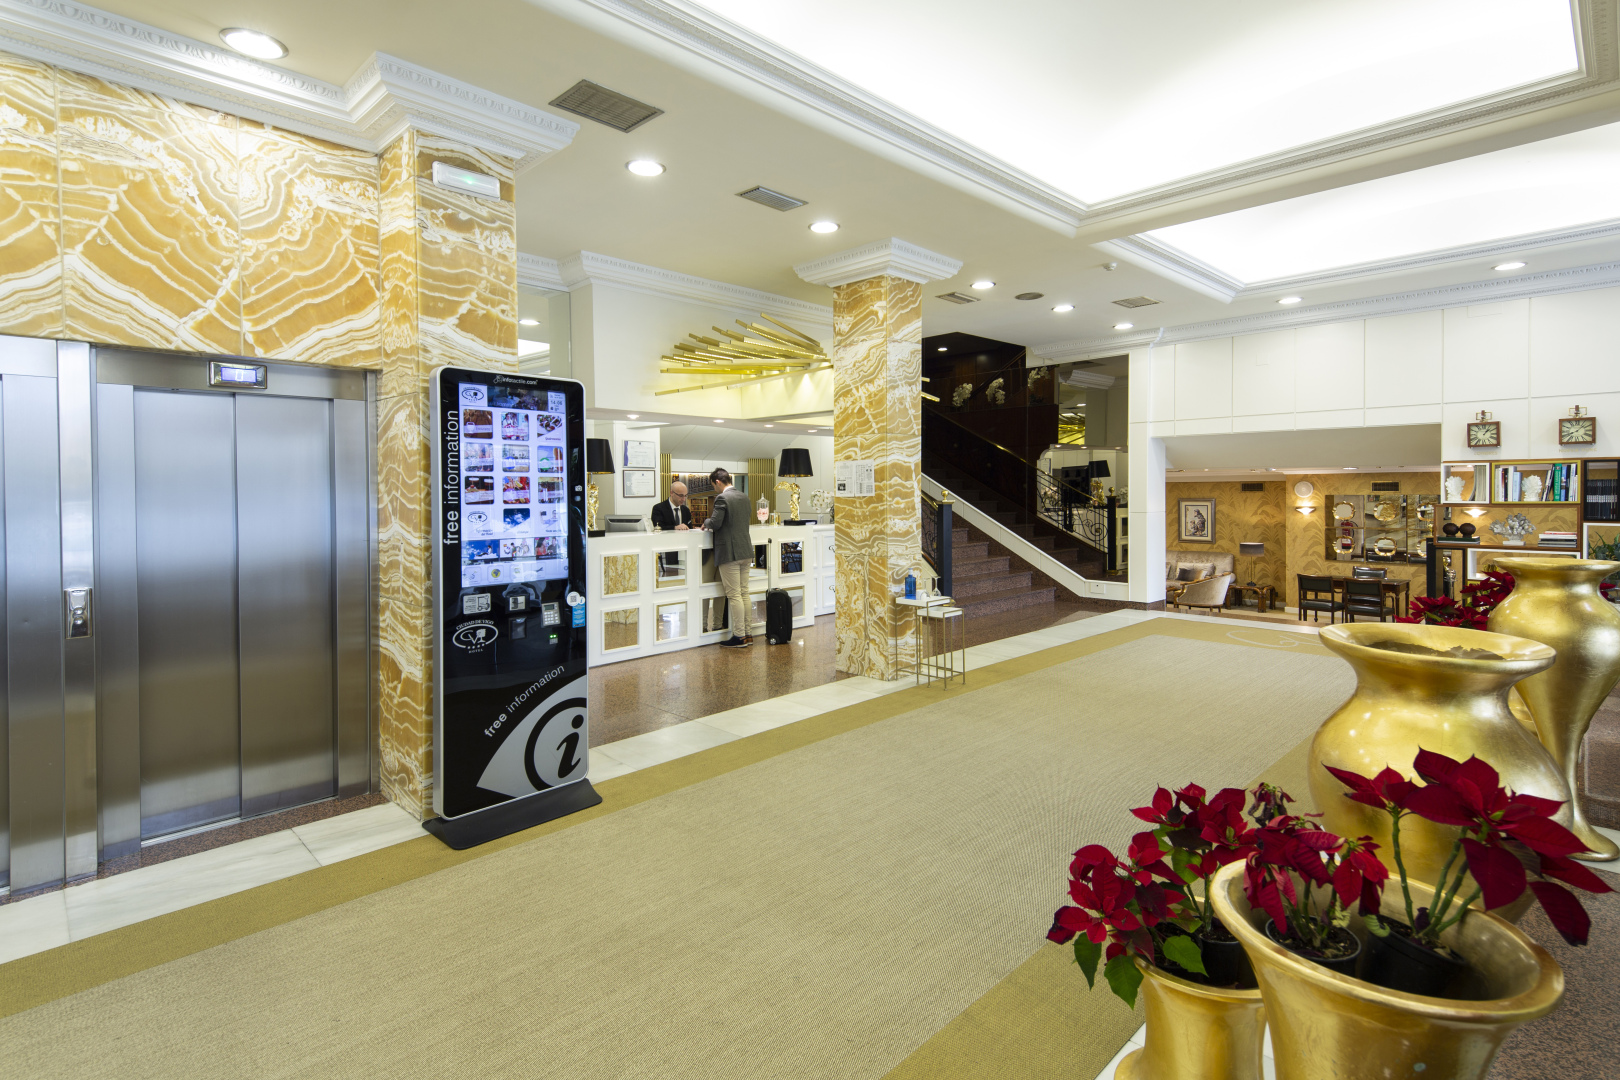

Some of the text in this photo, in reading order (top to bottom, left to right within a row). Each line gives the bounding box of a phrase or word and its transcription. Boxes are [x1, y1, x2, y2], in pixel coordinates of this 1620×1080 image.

[444, 410, 459, 544] free information
[484, 664, 565, 738] free information
